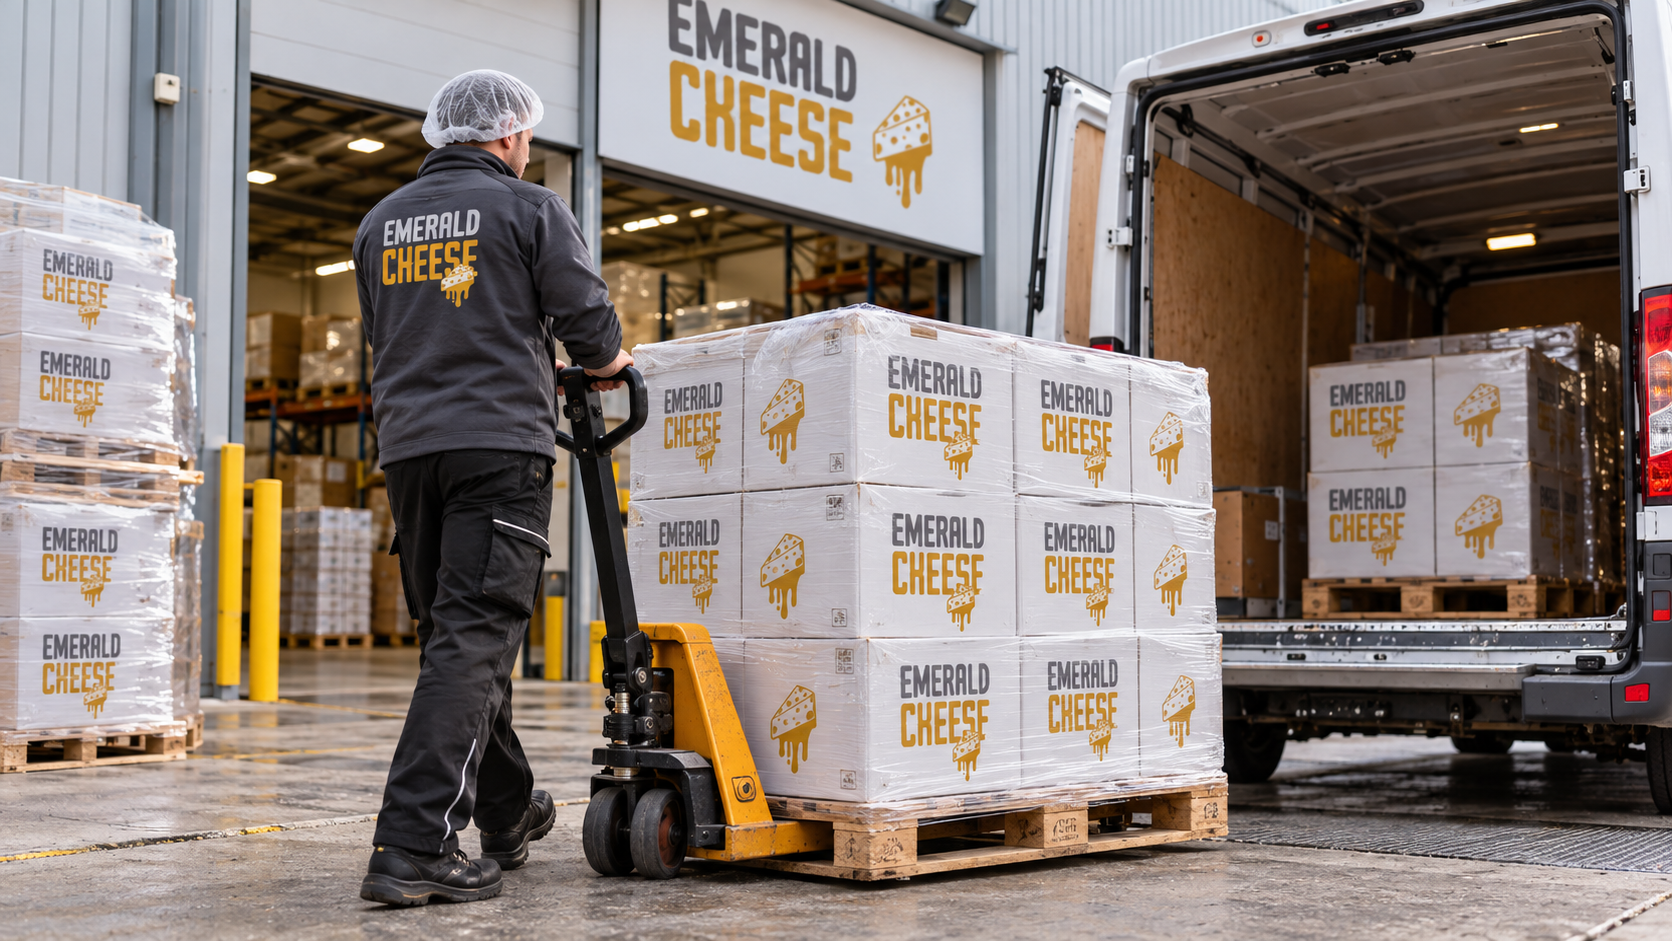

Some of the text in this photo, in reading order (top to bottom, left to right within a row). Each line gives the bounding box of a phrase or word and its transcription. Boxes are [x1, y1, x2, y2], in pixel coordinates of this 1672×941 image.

[668, 0, 857, 103] EMERALD
[383, 208, 480, 247] EMERALD
[43, 248, 113, 282] EMERALD
[382, 239, 478, 286] CHEESE
[42, 273, 109, 309] CHEESE
[40, 350, 111, 381] EMERALD
[888, 355, 982, 400] EMERALD
[39, 374, 105, 407] CHEESE
[664, 381, 723, 415] EMERALD
[1041, 379, 1113, 418] EMERALD
[1329, 380, 1406, 407] EMERALD
[663, 411, 722, 450] CHEESE
[1330, 405, 1406, 438] CHEESE
[1328, 486, 1406, 511] EMERALD
[42, 526, 118, 553] EMERALD
[658, 518, 720, 548] EMERALD
[891, 512, 985, 549] EMERALD
[1044, 521, 1115, 554] EMERALD
[1329, 512, 1406, 543] CHEESE
[41, 553, 113, 582] CHEESE
[658, 550, 719, 585] CHEESE
[42, 633, 121, 660] EMERALD
[42, 661, 116, 695] CHEESE
[900, 662, 990, 699] EMERALD
[1047, 659, 1119, 691] EMERALD
